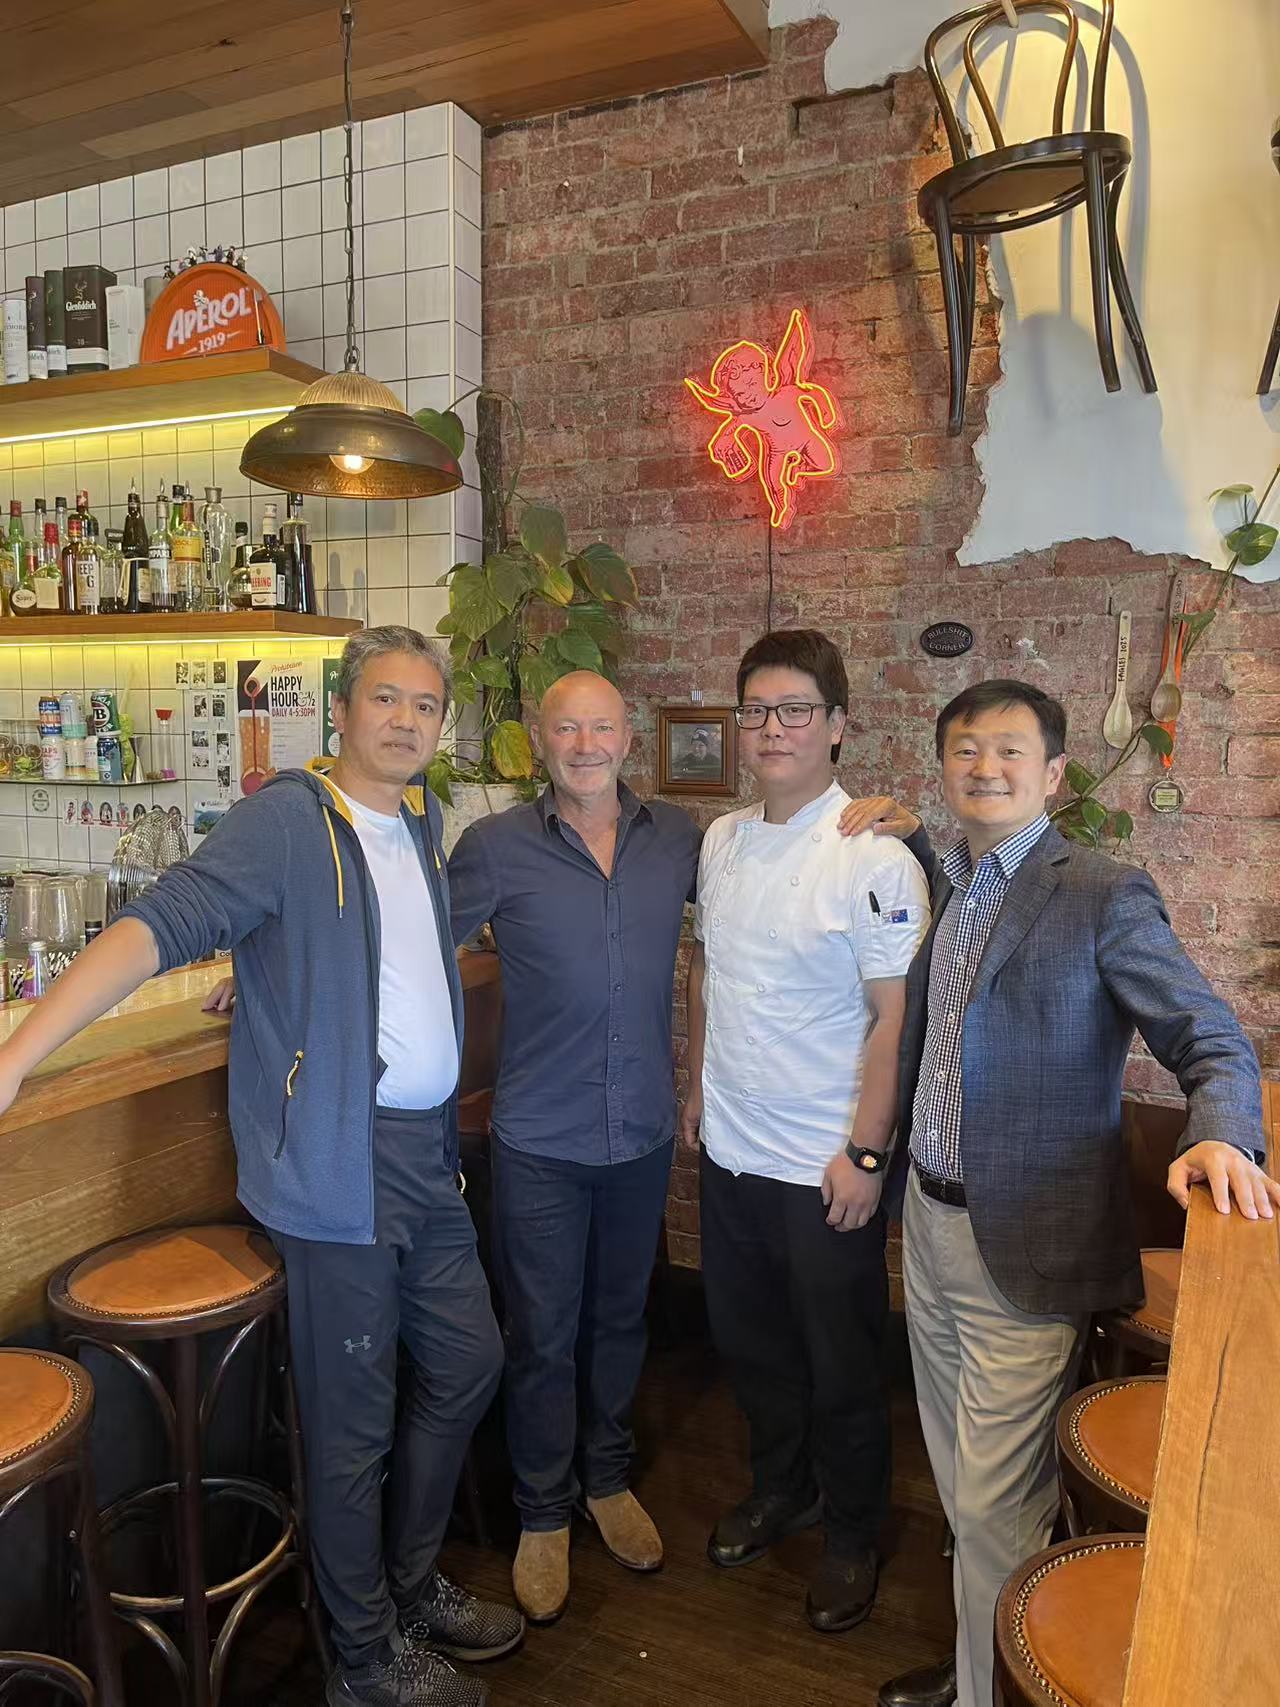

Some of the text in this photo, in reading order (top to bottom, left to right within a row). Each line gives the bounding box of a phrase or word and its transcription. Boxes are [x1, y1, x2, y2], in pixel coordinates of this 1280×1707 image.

[65, 300, 97, 312] Glenfiddich
[166, 287, 252, 351] APEROL
[198, 332, 226, 353] 1919
[79, 563, 94, 575] EEP
[927, 626, 968, 640] BULLSHIT
[929, 641, 966, 652] CORNER
[271, 676, 302, 691] HAPPY
[271, 692, 298, 708] HOUR
[271, 707, 288, 717] DAILY
